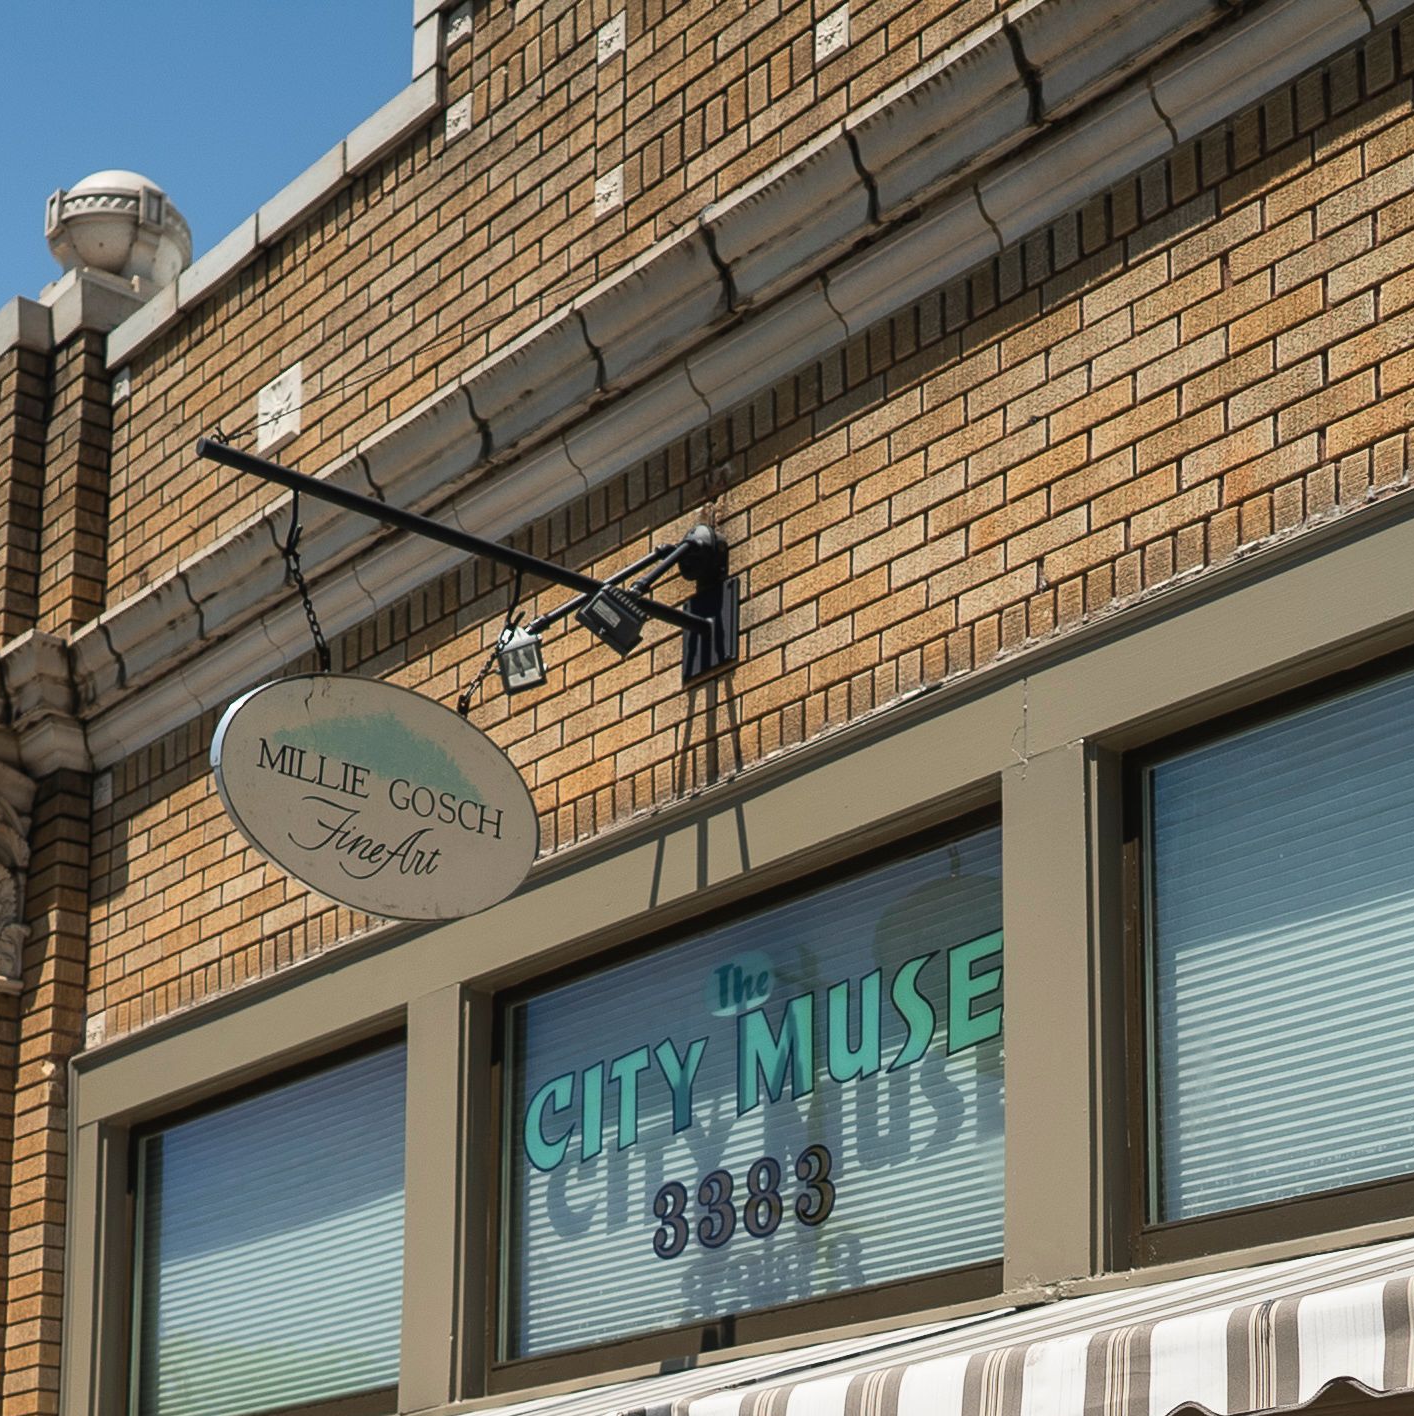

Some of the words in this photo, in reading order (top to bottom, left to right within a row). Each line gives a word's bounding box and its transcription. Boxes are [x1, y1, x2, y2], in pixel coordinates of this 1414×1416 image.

[255, 737, 371, 799] MILLIE
[388, 778, 505, 840] GOSCH
[713, 962, 770, 1010] The
[522, 1035, 710, 1173] CITY
[736, 928, 1004, 1119] MUSE
[652, 1144, 837, 1261] 3383
